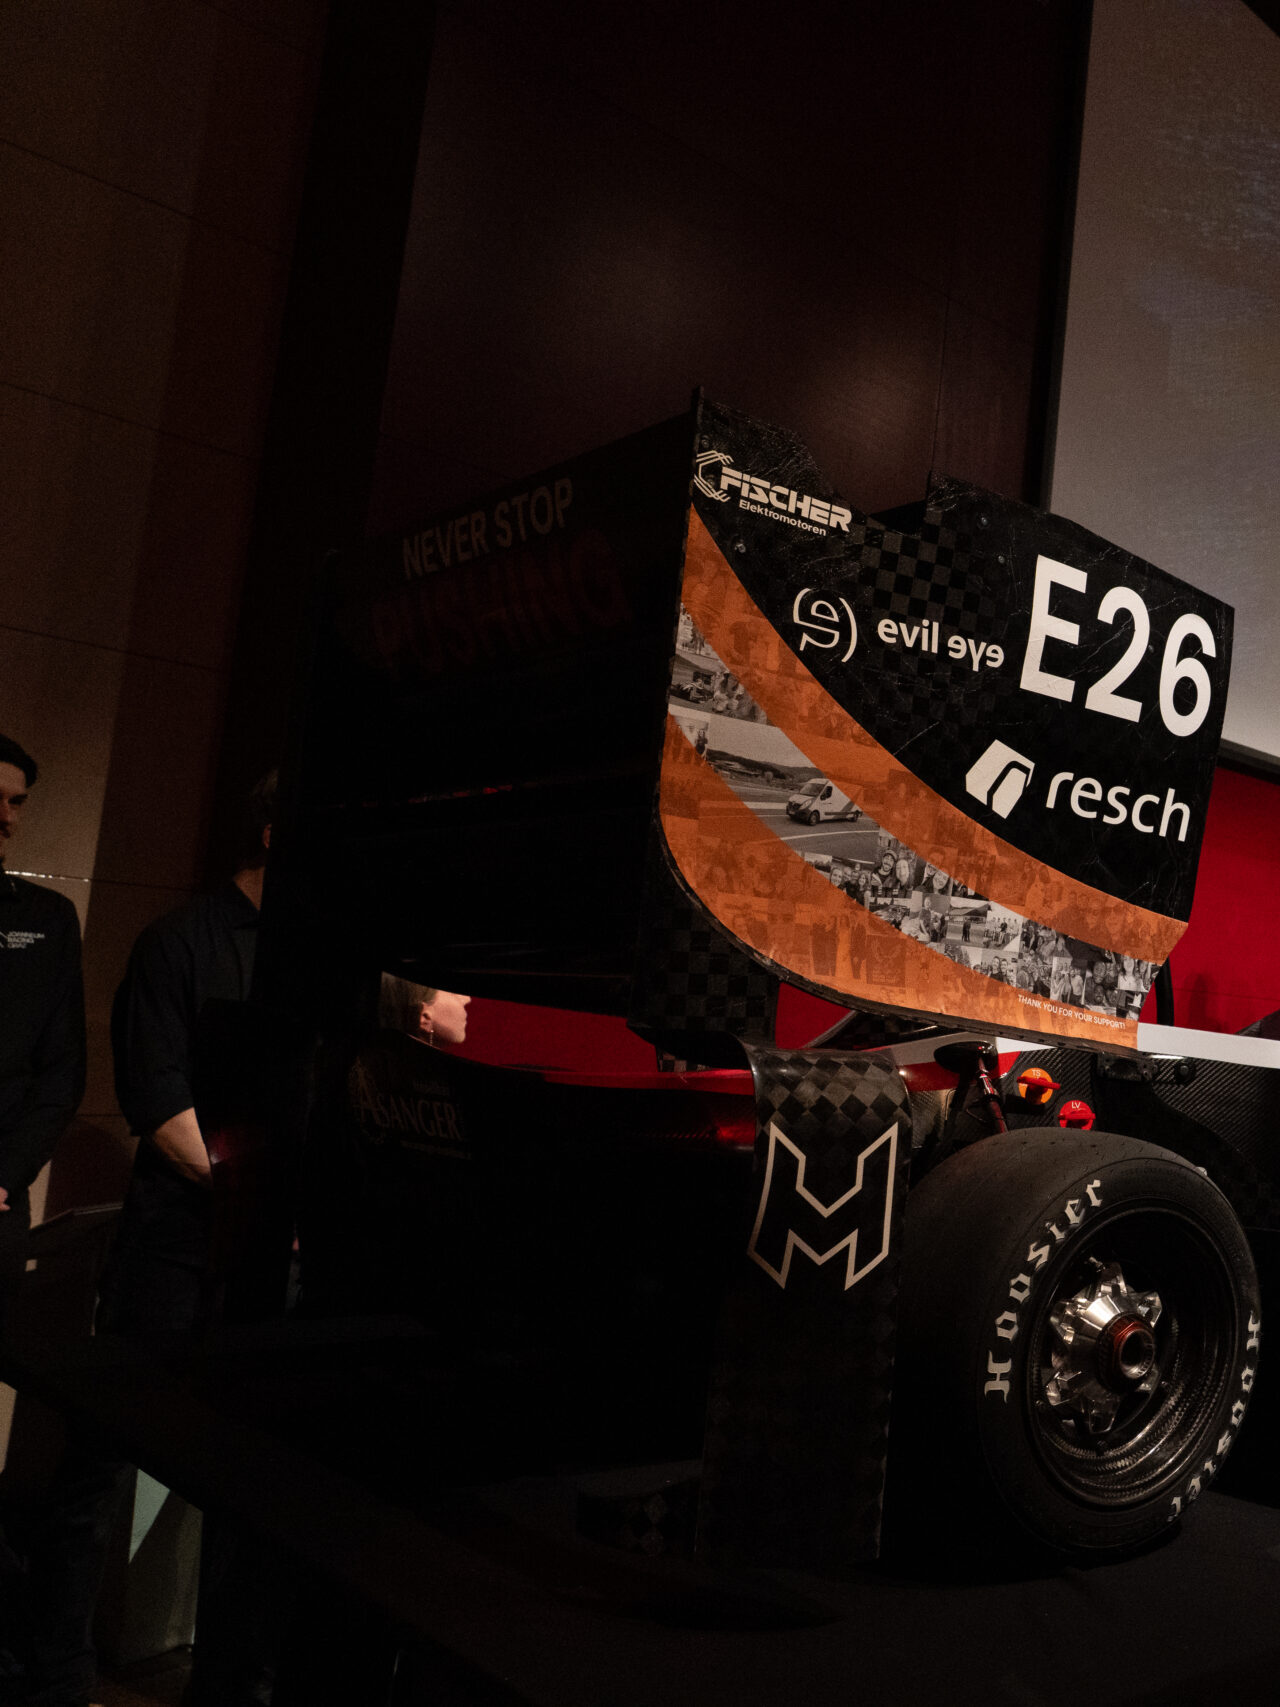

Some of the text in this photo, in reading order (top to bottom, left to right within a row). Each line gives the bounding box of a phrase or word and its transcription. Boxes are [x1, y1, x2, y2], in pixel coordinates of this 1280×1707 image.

[400, 478, 574, 581] NEVER STOP
[719, 466, 852, 533] FISCHER
[738, 498, 827, 536] Elektromotoren
[877, 619, 939, 654] evil
[1019, 554, 1217, 737] E26
[1045, 770, 1191, 842] resch
[1018, 994, 1126, 1030] THANK YOU FOR YOUR SUPPORT!
[1071, 1101, 1081, 1109] LV
[984, 1179, 1101, 1405] Hoosier
